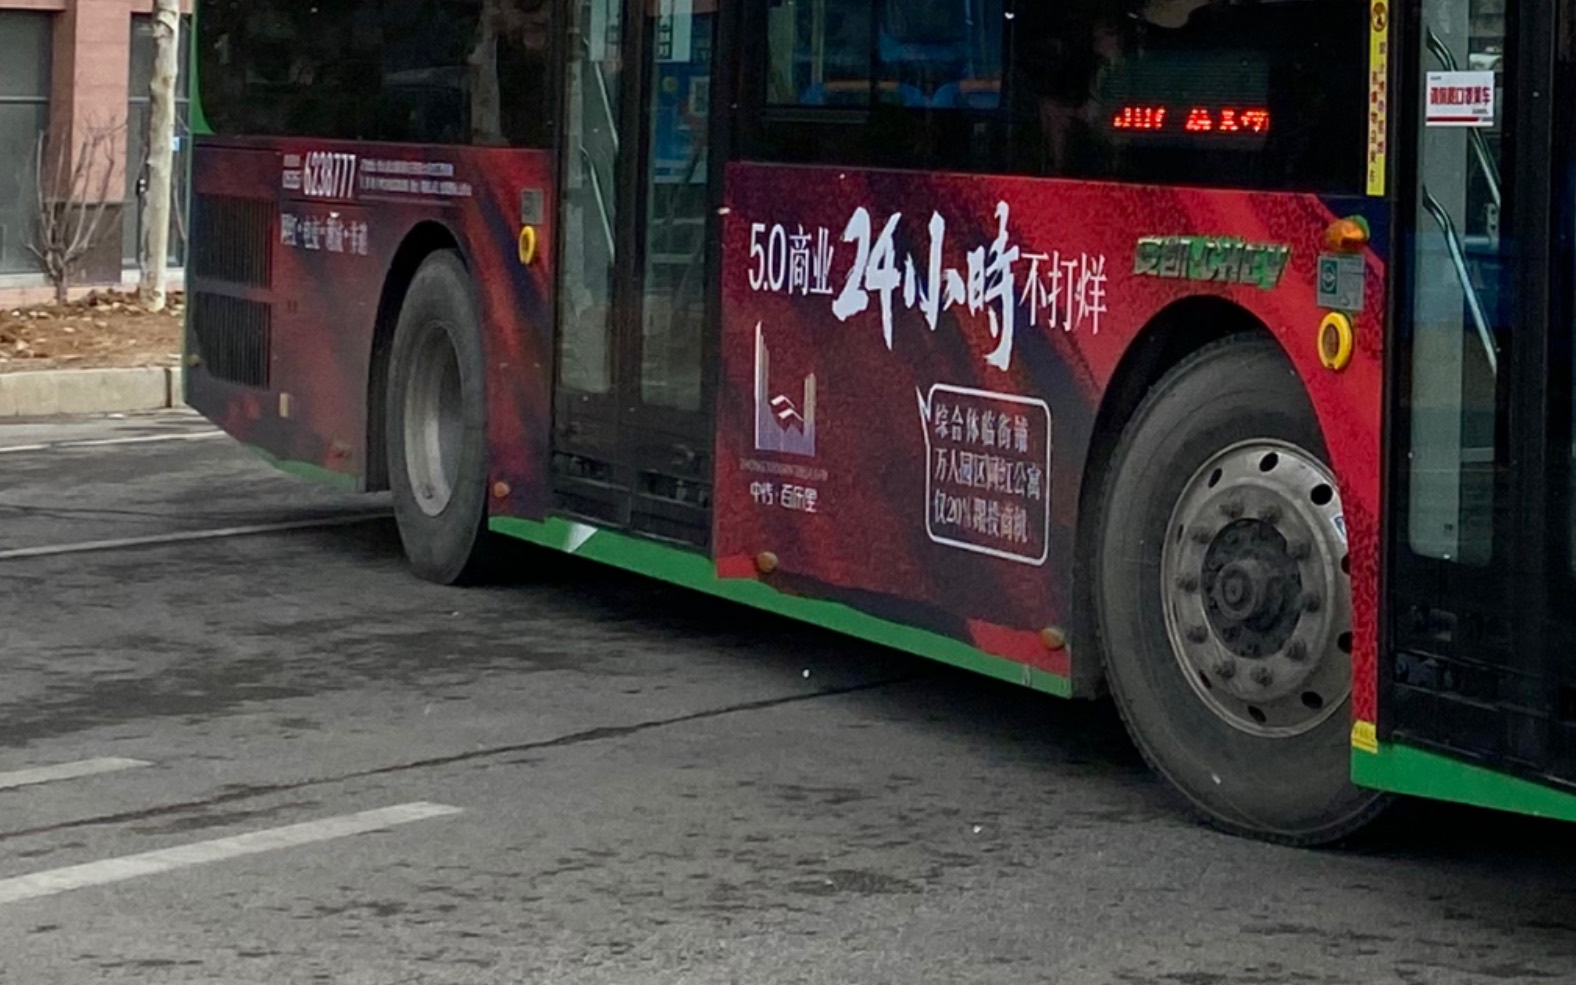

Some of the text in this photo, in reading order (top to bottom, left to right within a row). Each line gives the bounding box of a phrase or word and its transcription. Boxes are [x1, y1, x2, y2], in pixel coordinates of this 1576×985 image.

[303, 152, 356, 198] 6238777
[748, 223, 834, 296] 5.0商业
[1018, 252, 1108, 335] 不打烊
